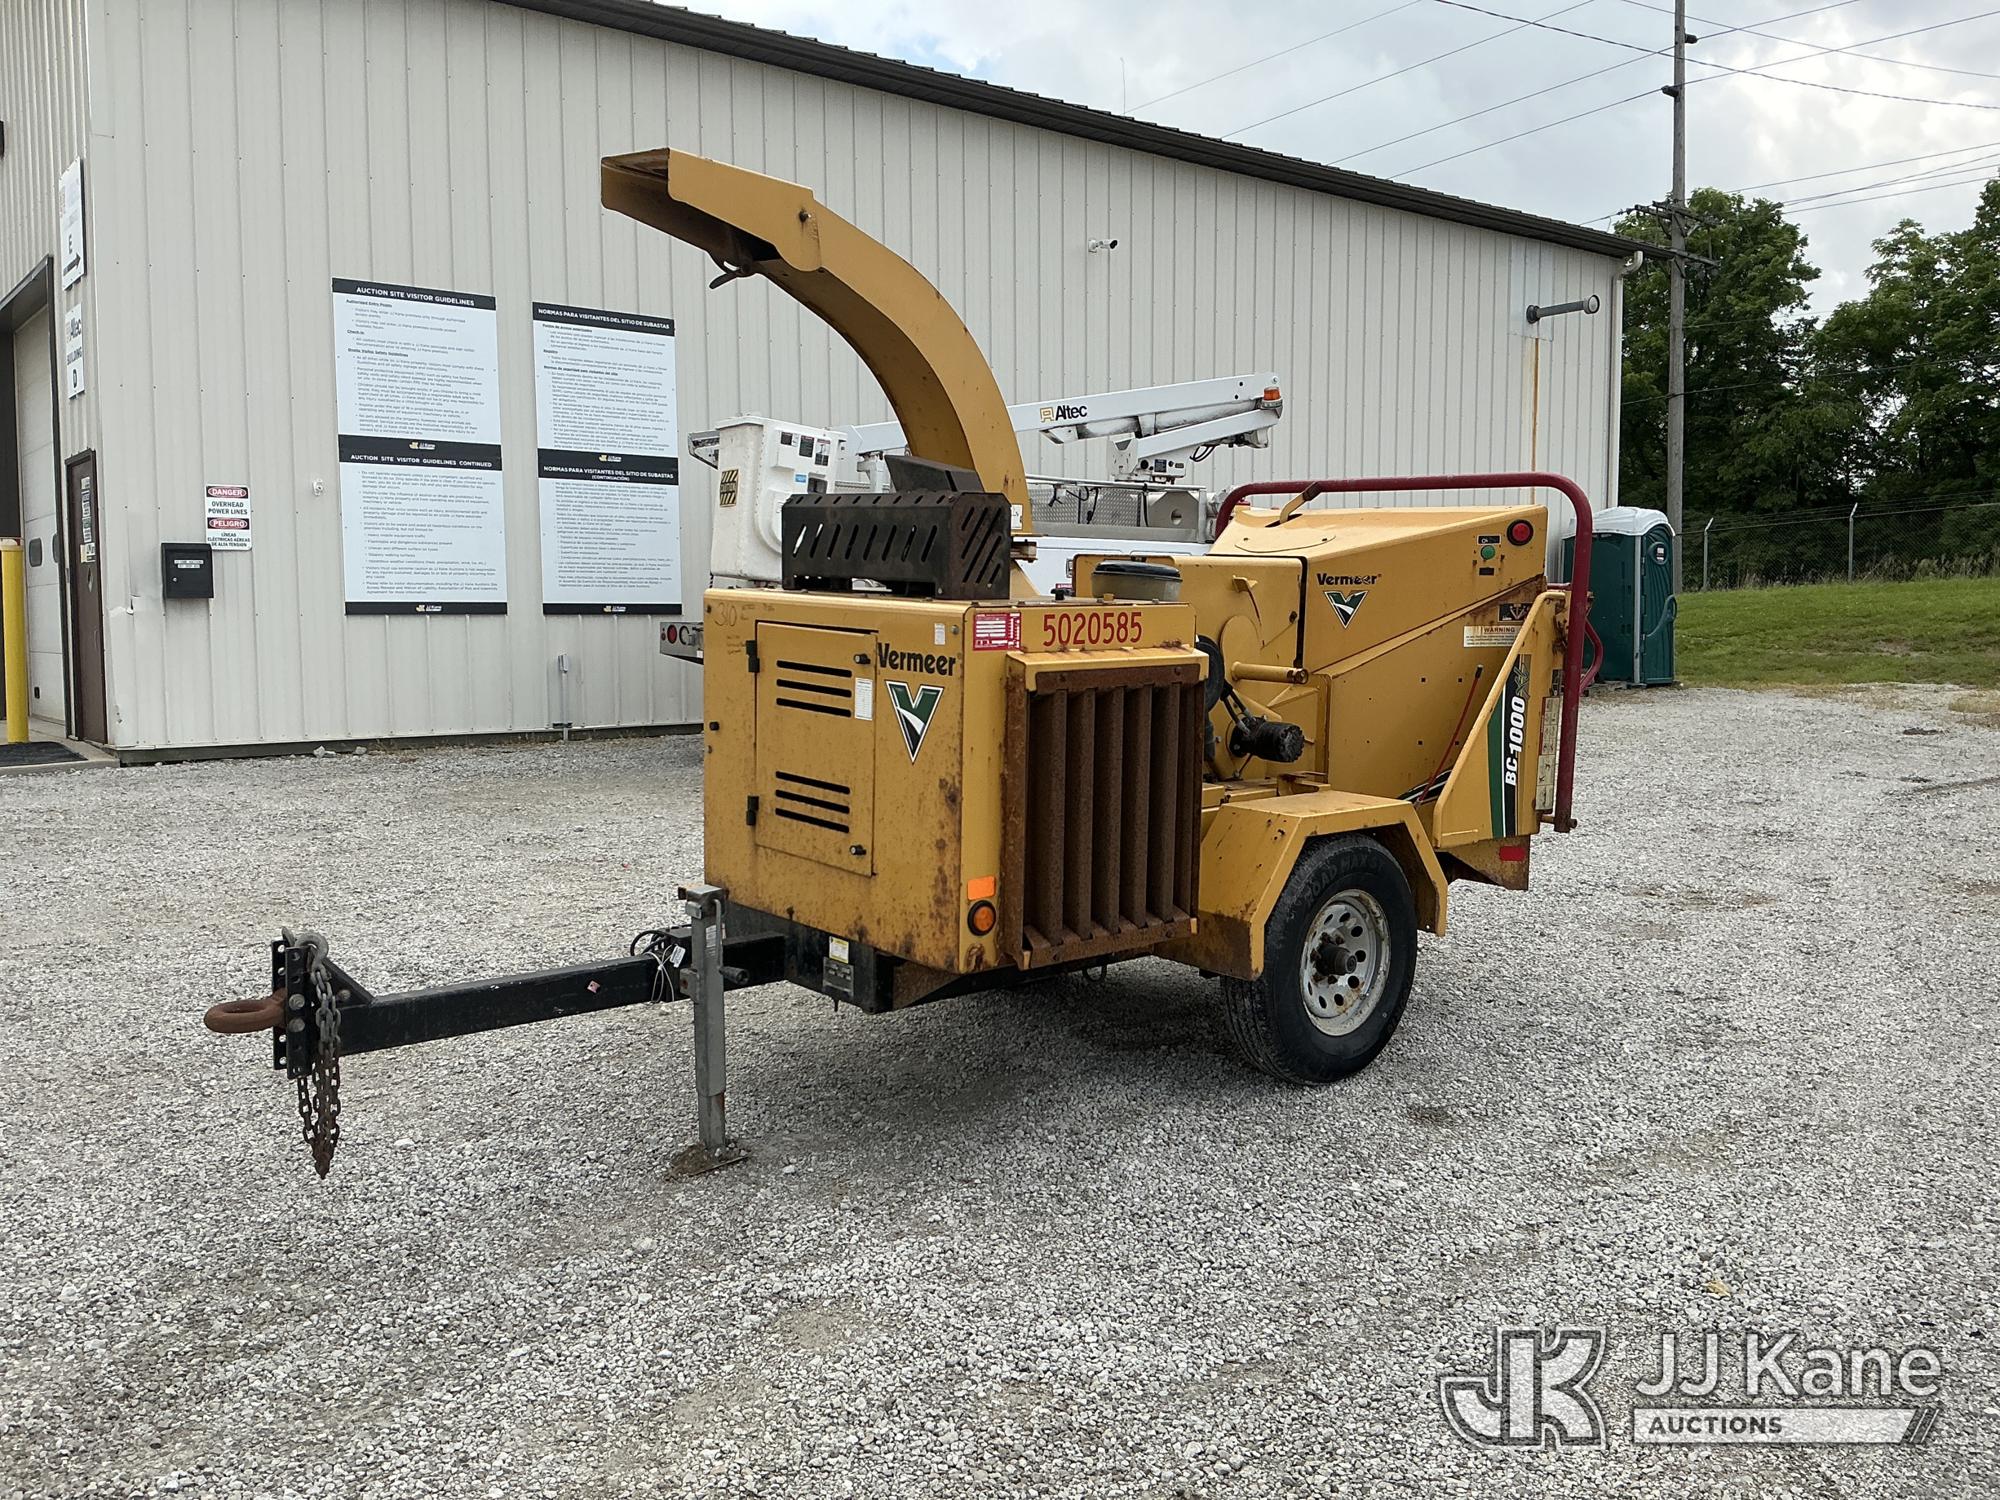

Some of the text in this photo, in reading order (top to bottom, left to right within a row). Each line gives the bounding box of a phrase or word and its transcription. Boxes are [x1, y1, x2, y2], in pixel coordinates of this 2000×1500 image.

[357, 287, 475, 306] AUCTION SITE VISITOR GUIDELINES
[538, 308, 562, 316] NORMAS
[579, 313, 610, 322] VISITANTES
[643, 321, 670, 329] SUBASTAS
[1056, 405, 1087, 421] Altec
[212, 488, 243, 496] DANGER
[1317, 573, 1377, 585] Vermeer
[1043, 611, 1142, 646] 5020585
[878, 643, 956, 676] Vermeer
[1510, 696, 1526, 753] 1000
[1505, 756, 1518, 786] BC
